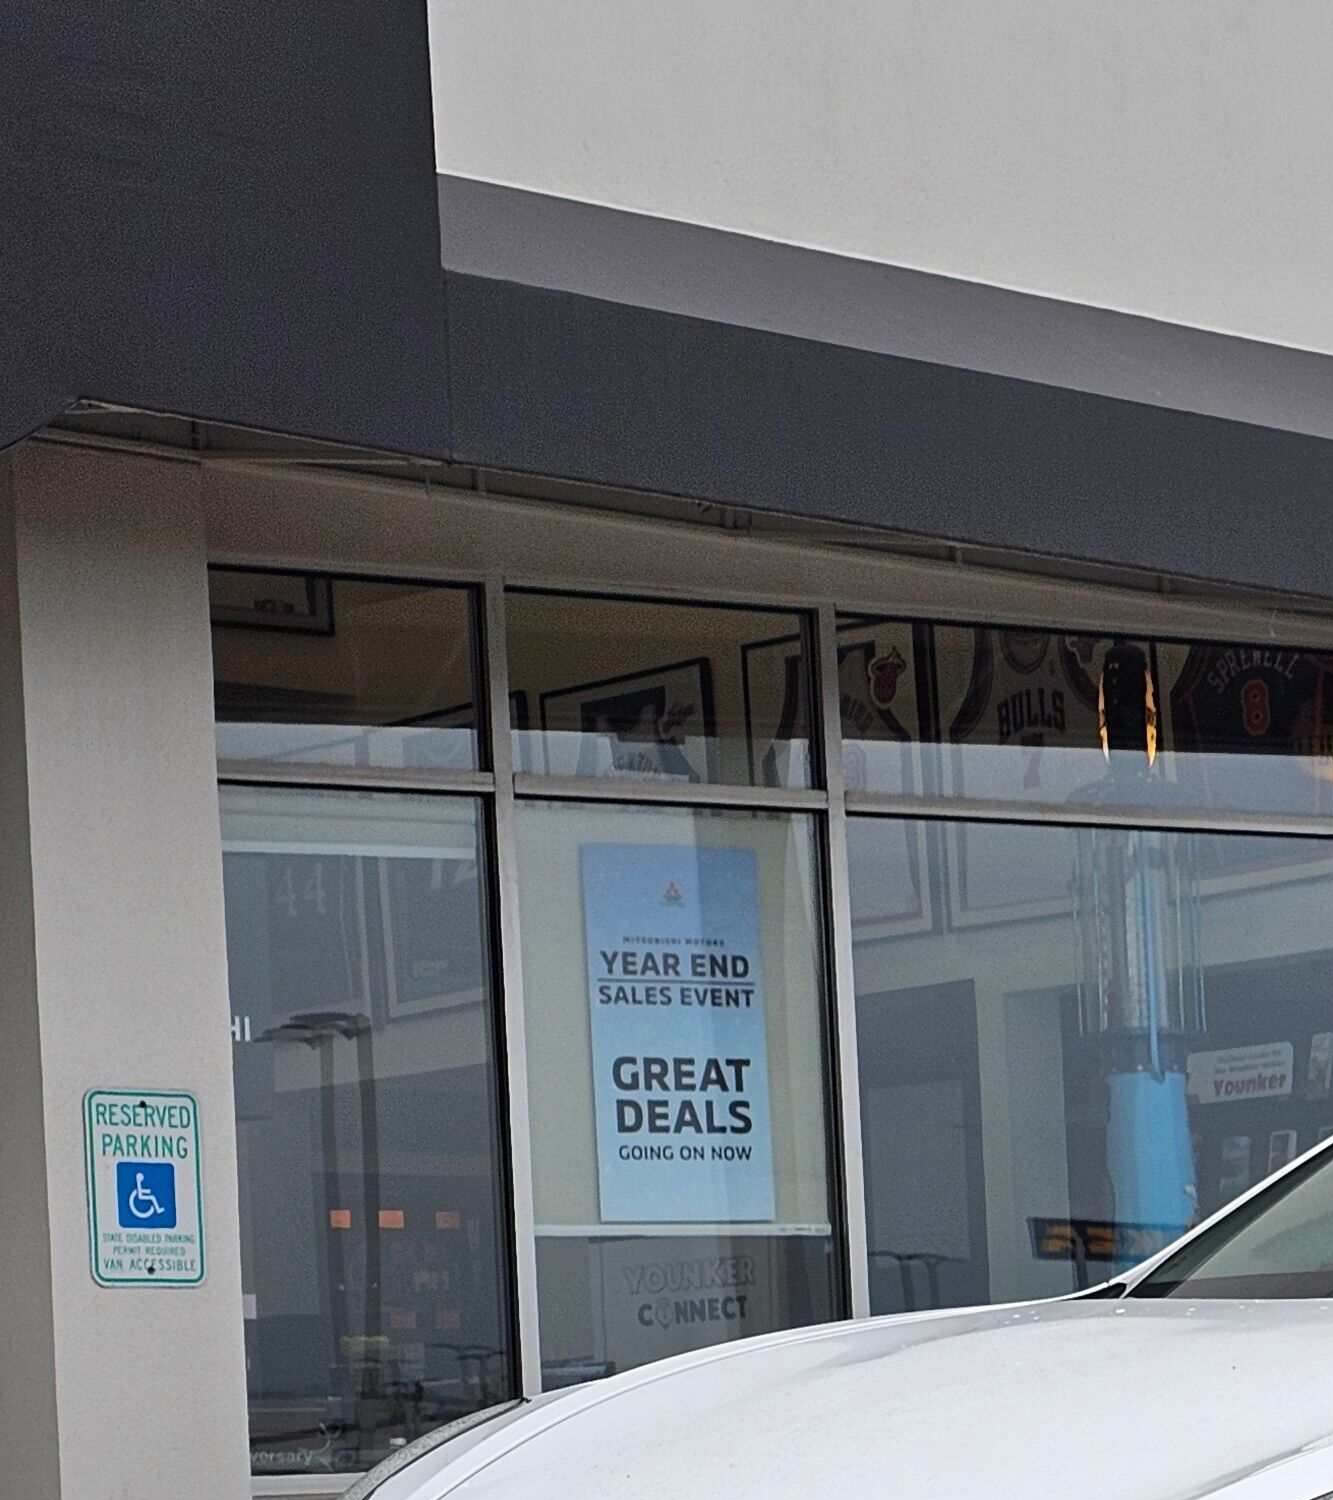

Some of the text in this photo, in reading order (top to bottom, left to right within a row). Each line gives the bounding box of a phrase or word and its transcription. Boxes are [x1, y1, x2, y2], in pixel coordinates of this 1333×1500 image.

[997, 687, 1067, 739] BULLS
[1241, 676, 1271, 737] 8
[600, 950, 750, 979] YEAR END
[598, 985, 754, 1008] SALES EVENT
[612, 1056, 751, 1093] GREAT
[95, 1102, 191, 1129] RESERVED
[616, 1099, 753, 1134] DEALS
[102, 1133, 188, 1159] PARKING
[618, 1145, 753, 1162] GOING ON NOW
[112, 1246, 186, 1257] PERMIT REQUIRED
[125, 1233, 162, 1244] DISABLED
[164, 1234, 196, 1245] PARKING
[103, 1258, 197, 1273] VAN ACCESSIBLE
